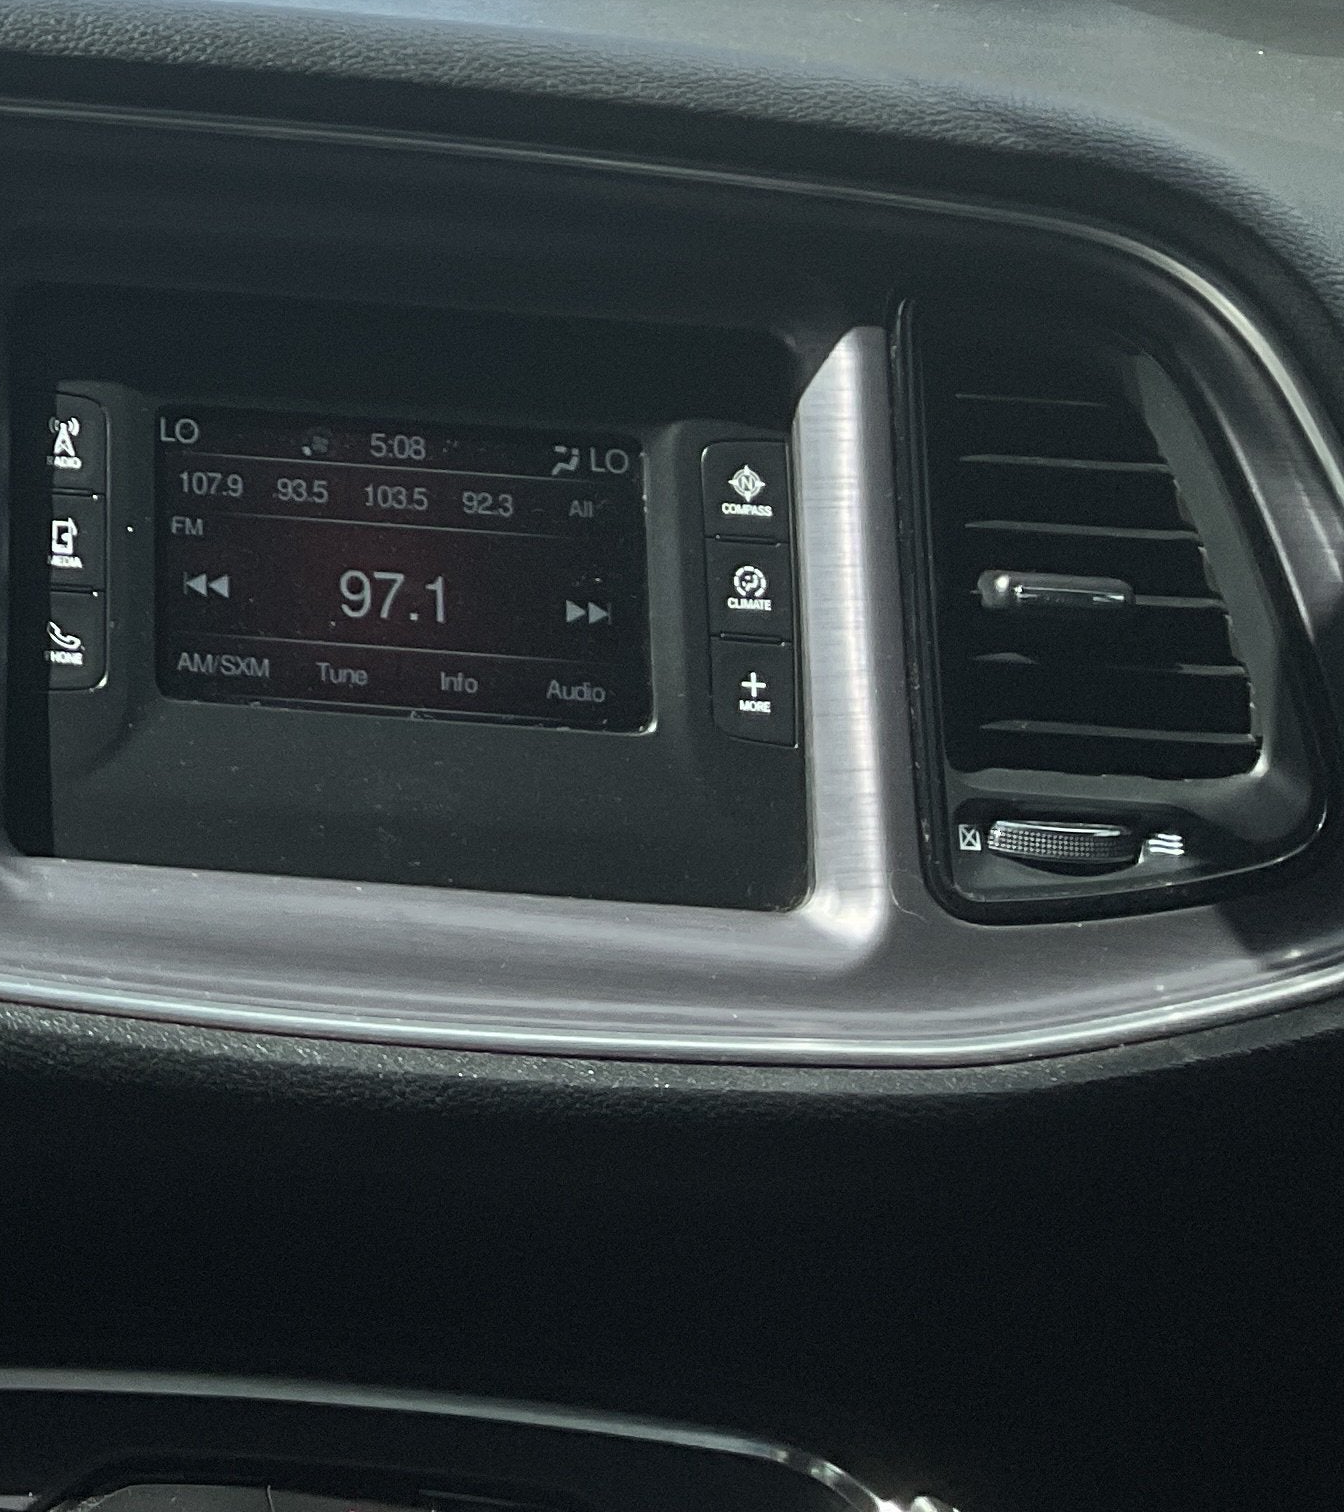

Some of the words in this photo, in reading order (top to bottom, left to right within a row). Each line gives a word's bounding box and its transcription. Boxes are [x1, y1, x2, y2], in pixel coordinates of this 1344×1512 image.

[160, 418, 201, 444] LO
[369, 432, 427, 461] 5:08
[589, 448, 630, 474] LO
[179, 471, 244, 498] 107.9
[276, 477, 330, 504] 93.5
[364, 484, 430, 512] 103.5
[462, 490, 514, 518] 92.3
[721, 502, 773, 517] COMPASS
[170, 516, 205, 536] FM
[337, 569, 448, 625] 97.1
[727, 597, 772, 611] CLIMATE
[177, 651, 272, 679] AM/SXM
[316, 662, 370, 687] Tune
[439, 671, 480, 695] Info
[546, 678, 608, 704] Audio
[739, 699, 771, 714] MORE
